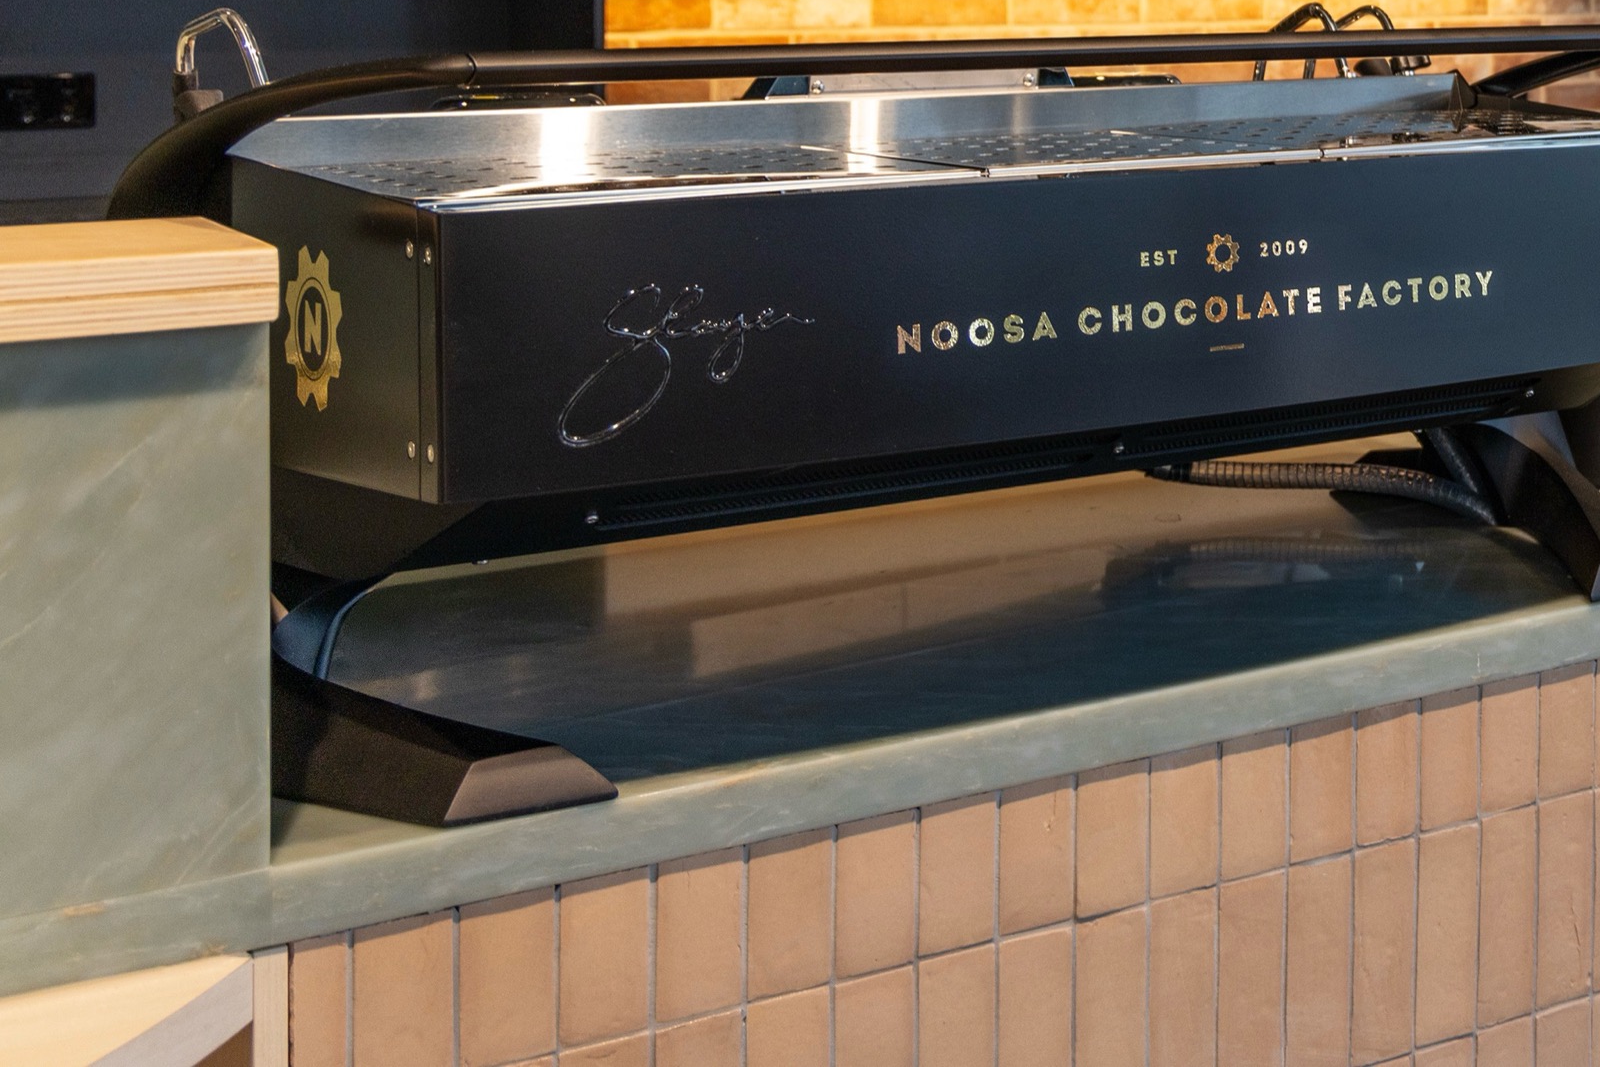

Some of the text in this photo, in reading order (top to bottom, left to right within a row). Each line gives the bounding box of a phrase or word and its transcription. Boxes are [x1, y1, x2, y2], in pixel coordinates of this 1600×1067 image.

[1139, 238, 1309, 268] EST 2009
[304, 300, 322, 357] N
[896, 270, 1494, 355] NOOSA CHOCOLATE FACTORY
